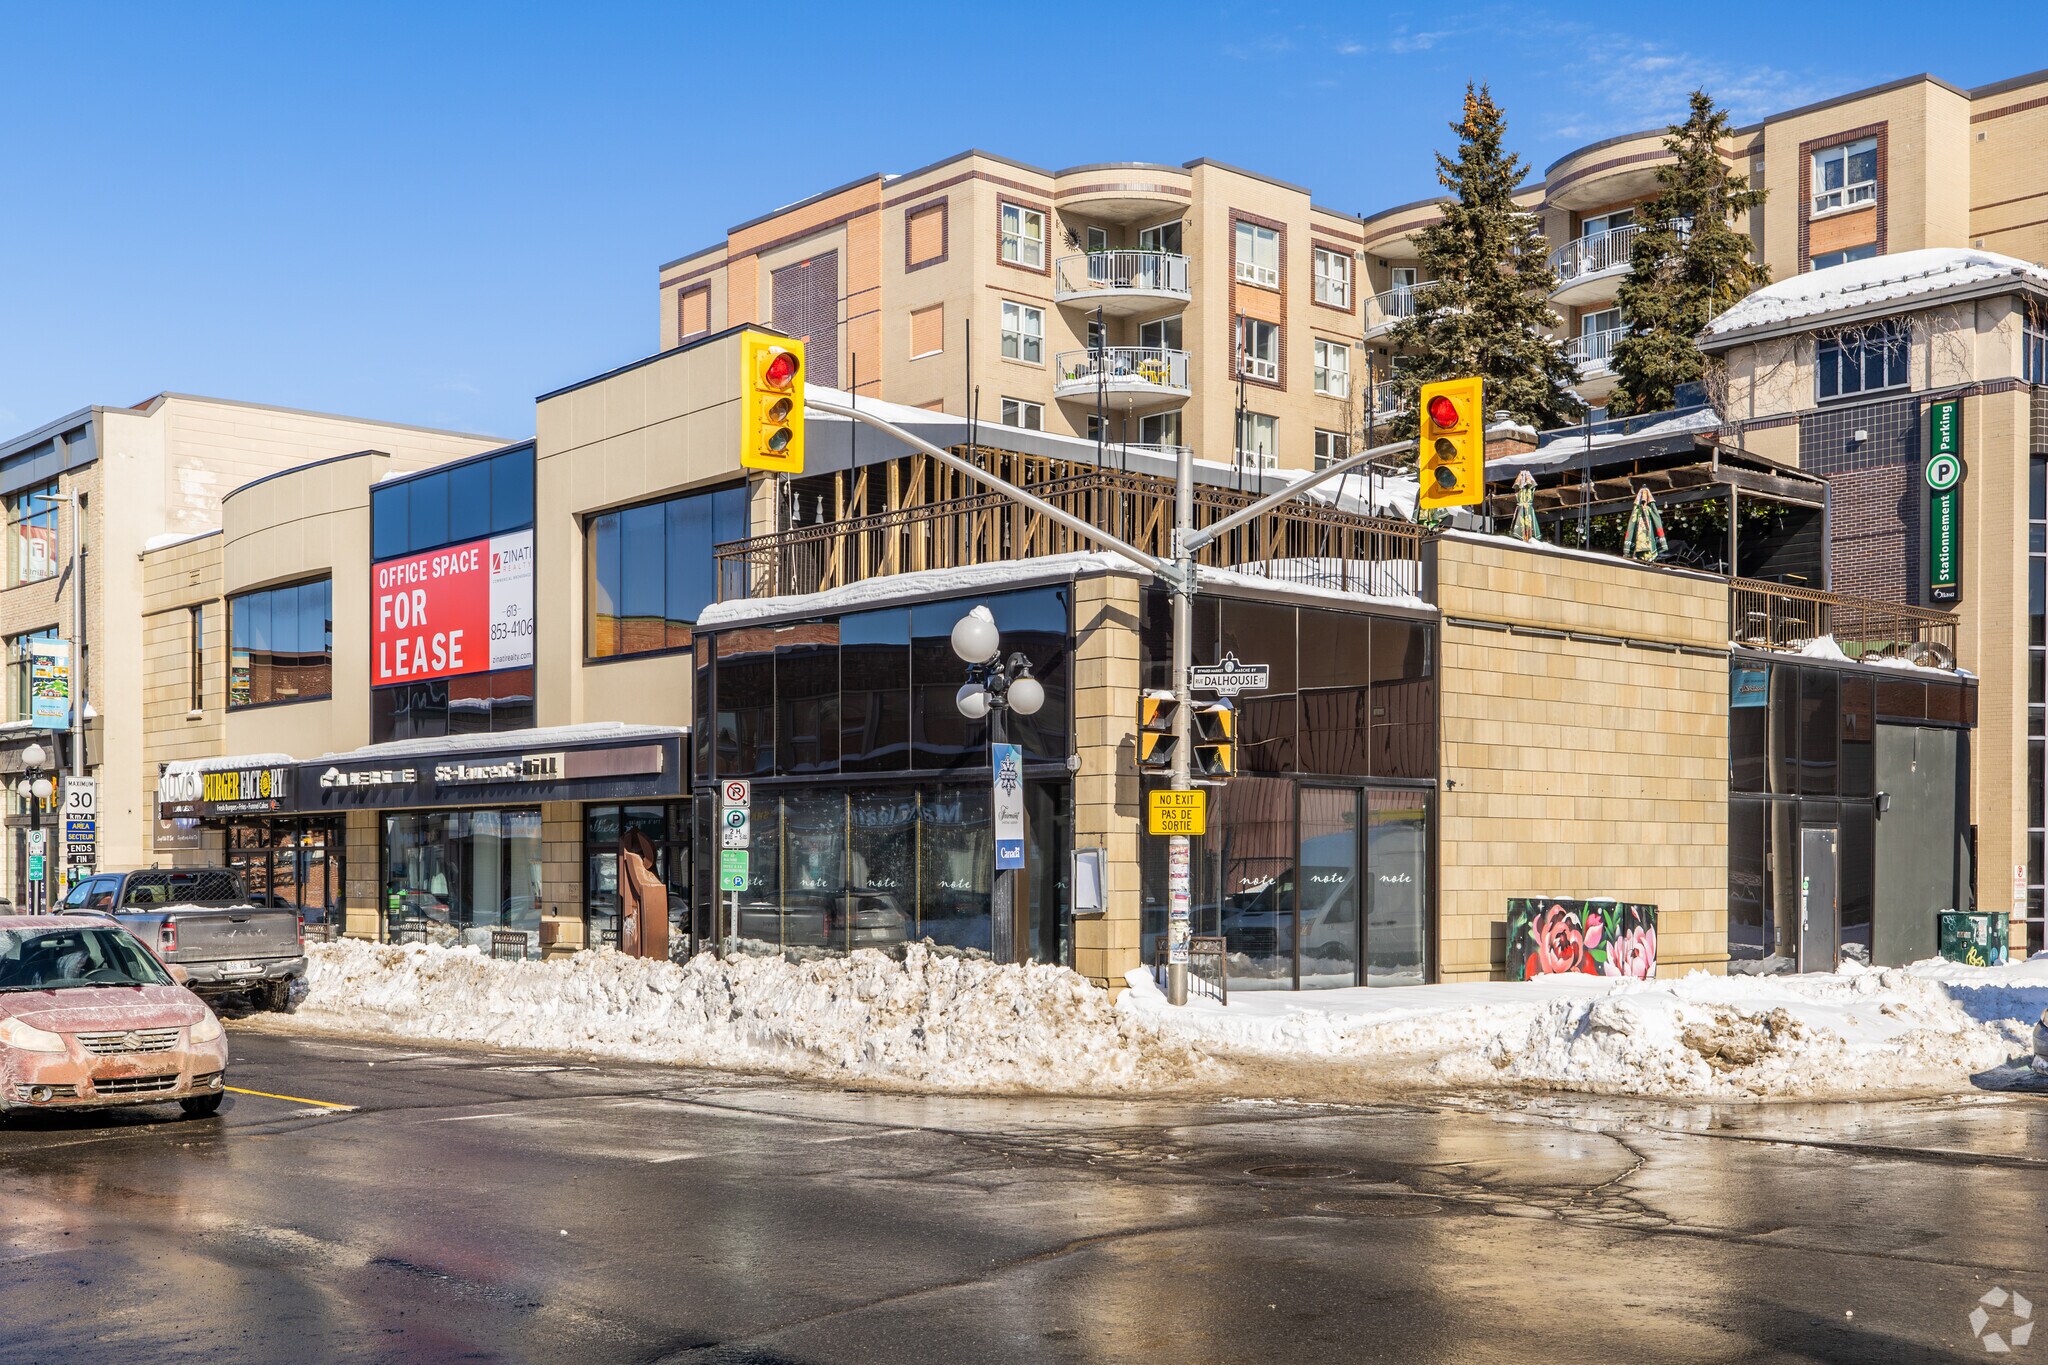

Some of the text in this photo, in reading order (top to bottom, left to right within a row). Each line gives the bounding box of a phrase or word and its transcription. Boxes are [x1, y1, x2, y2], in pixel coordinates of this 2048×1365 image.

[1940, 405, 1952, 450] Parking
[1939, 495, 1950, 581] Stationnement
[503, 546, 532, 564] ZINATI
[380, 549, 479, 589] OFFICE SPACE
[503, 562, 532, 572] REALTY
[380, 589, 427, 633] FOR
[491, 618, 533, 641] 853-4106
[380, 629, 464, 679] LEASE
[493, 652, 532, 664] zinatirealty.com
[1204, 675, 1258, 686] DALHOUSIE
[203, 772, 239, 802] BURGER
[240, 768, 285, 800] FACTORY
[69, 792, 92, 808] 30
[1160, 794, 1194, 805] NO EXIT
[216, 804, 226, 812] Fresh
[1161, 810, 1192, 819] PAS DE
[1162, 820, 1192, 831] SORTIE
[1000, 847, 1020, 858] Canada
[800, 877, 828, 888] note
[866, 877, 897, 888] note
[938, 876, 972, 889] note
[1239, 874, 1276, 886] note
[1310, 872, 1345, 883] note
[1379, 872, 1412, 883] note
